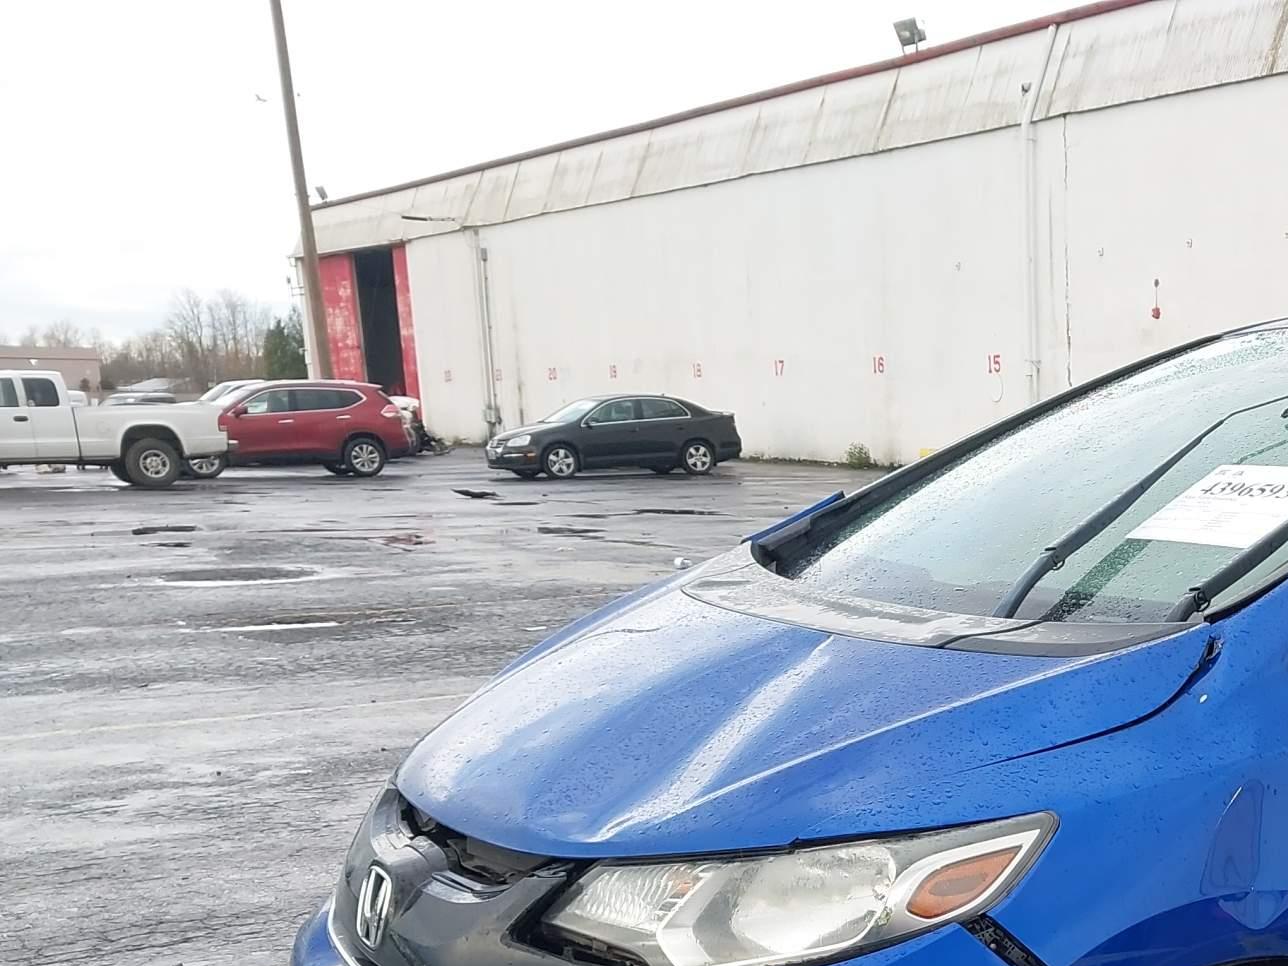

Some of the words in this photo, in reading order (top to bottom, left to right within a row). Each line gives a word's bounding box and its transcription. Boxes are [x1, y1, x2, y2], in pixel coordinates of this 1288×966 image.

[774, 359, 786, 377] 17
[872, 355, 886, 375] 16
[987, 354, 1002, 375] 15
